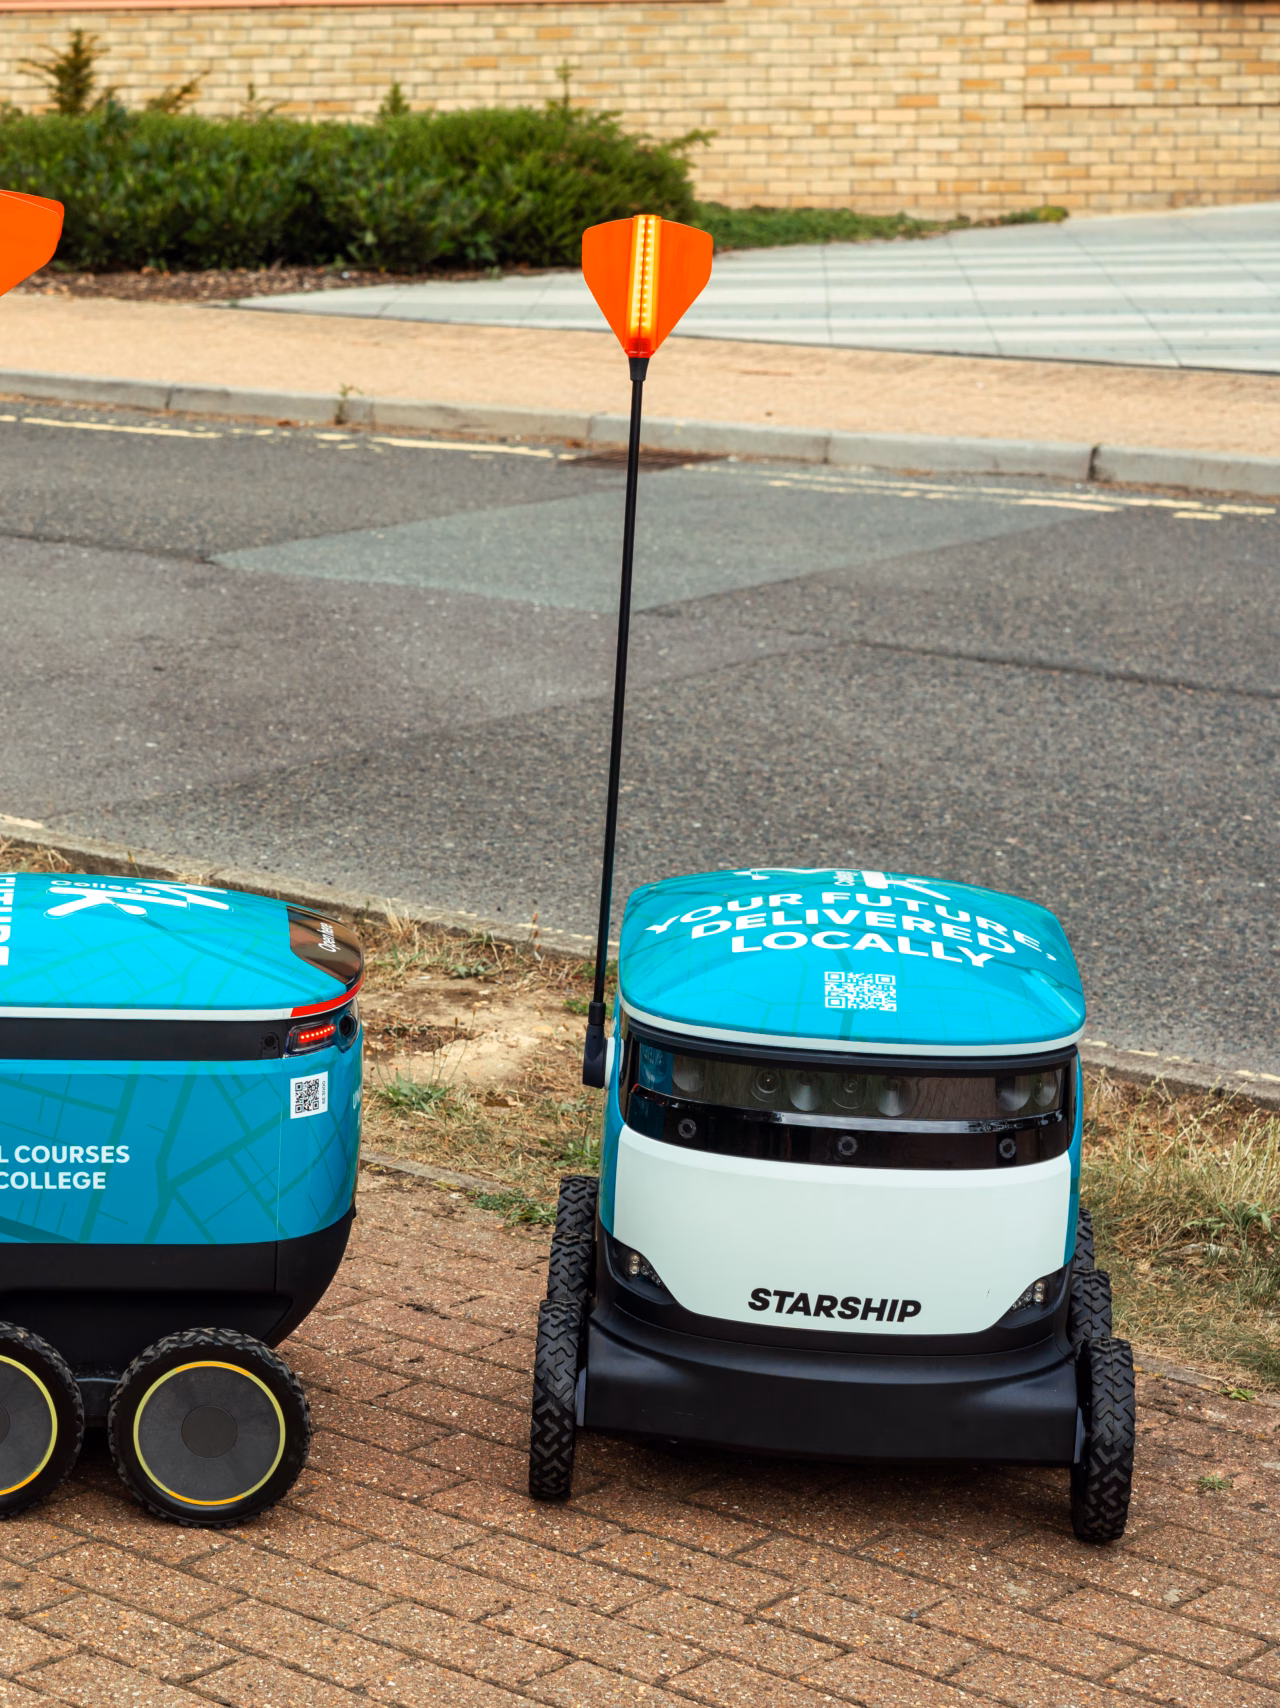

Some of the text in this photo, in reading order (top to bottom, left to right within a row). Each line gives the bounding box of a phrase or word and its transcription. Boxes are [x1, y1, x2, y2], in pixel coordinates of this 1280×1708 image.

[645, 890, 1058, 961] YOUR FUTURE,
[691, 909, 1016, 954] DELIVERED
[731, 931, 995, 968] LOCALLY
[14, 1145, 130, 1164] COURSES
[747, 1287, 922, 1323] STARSHIP
